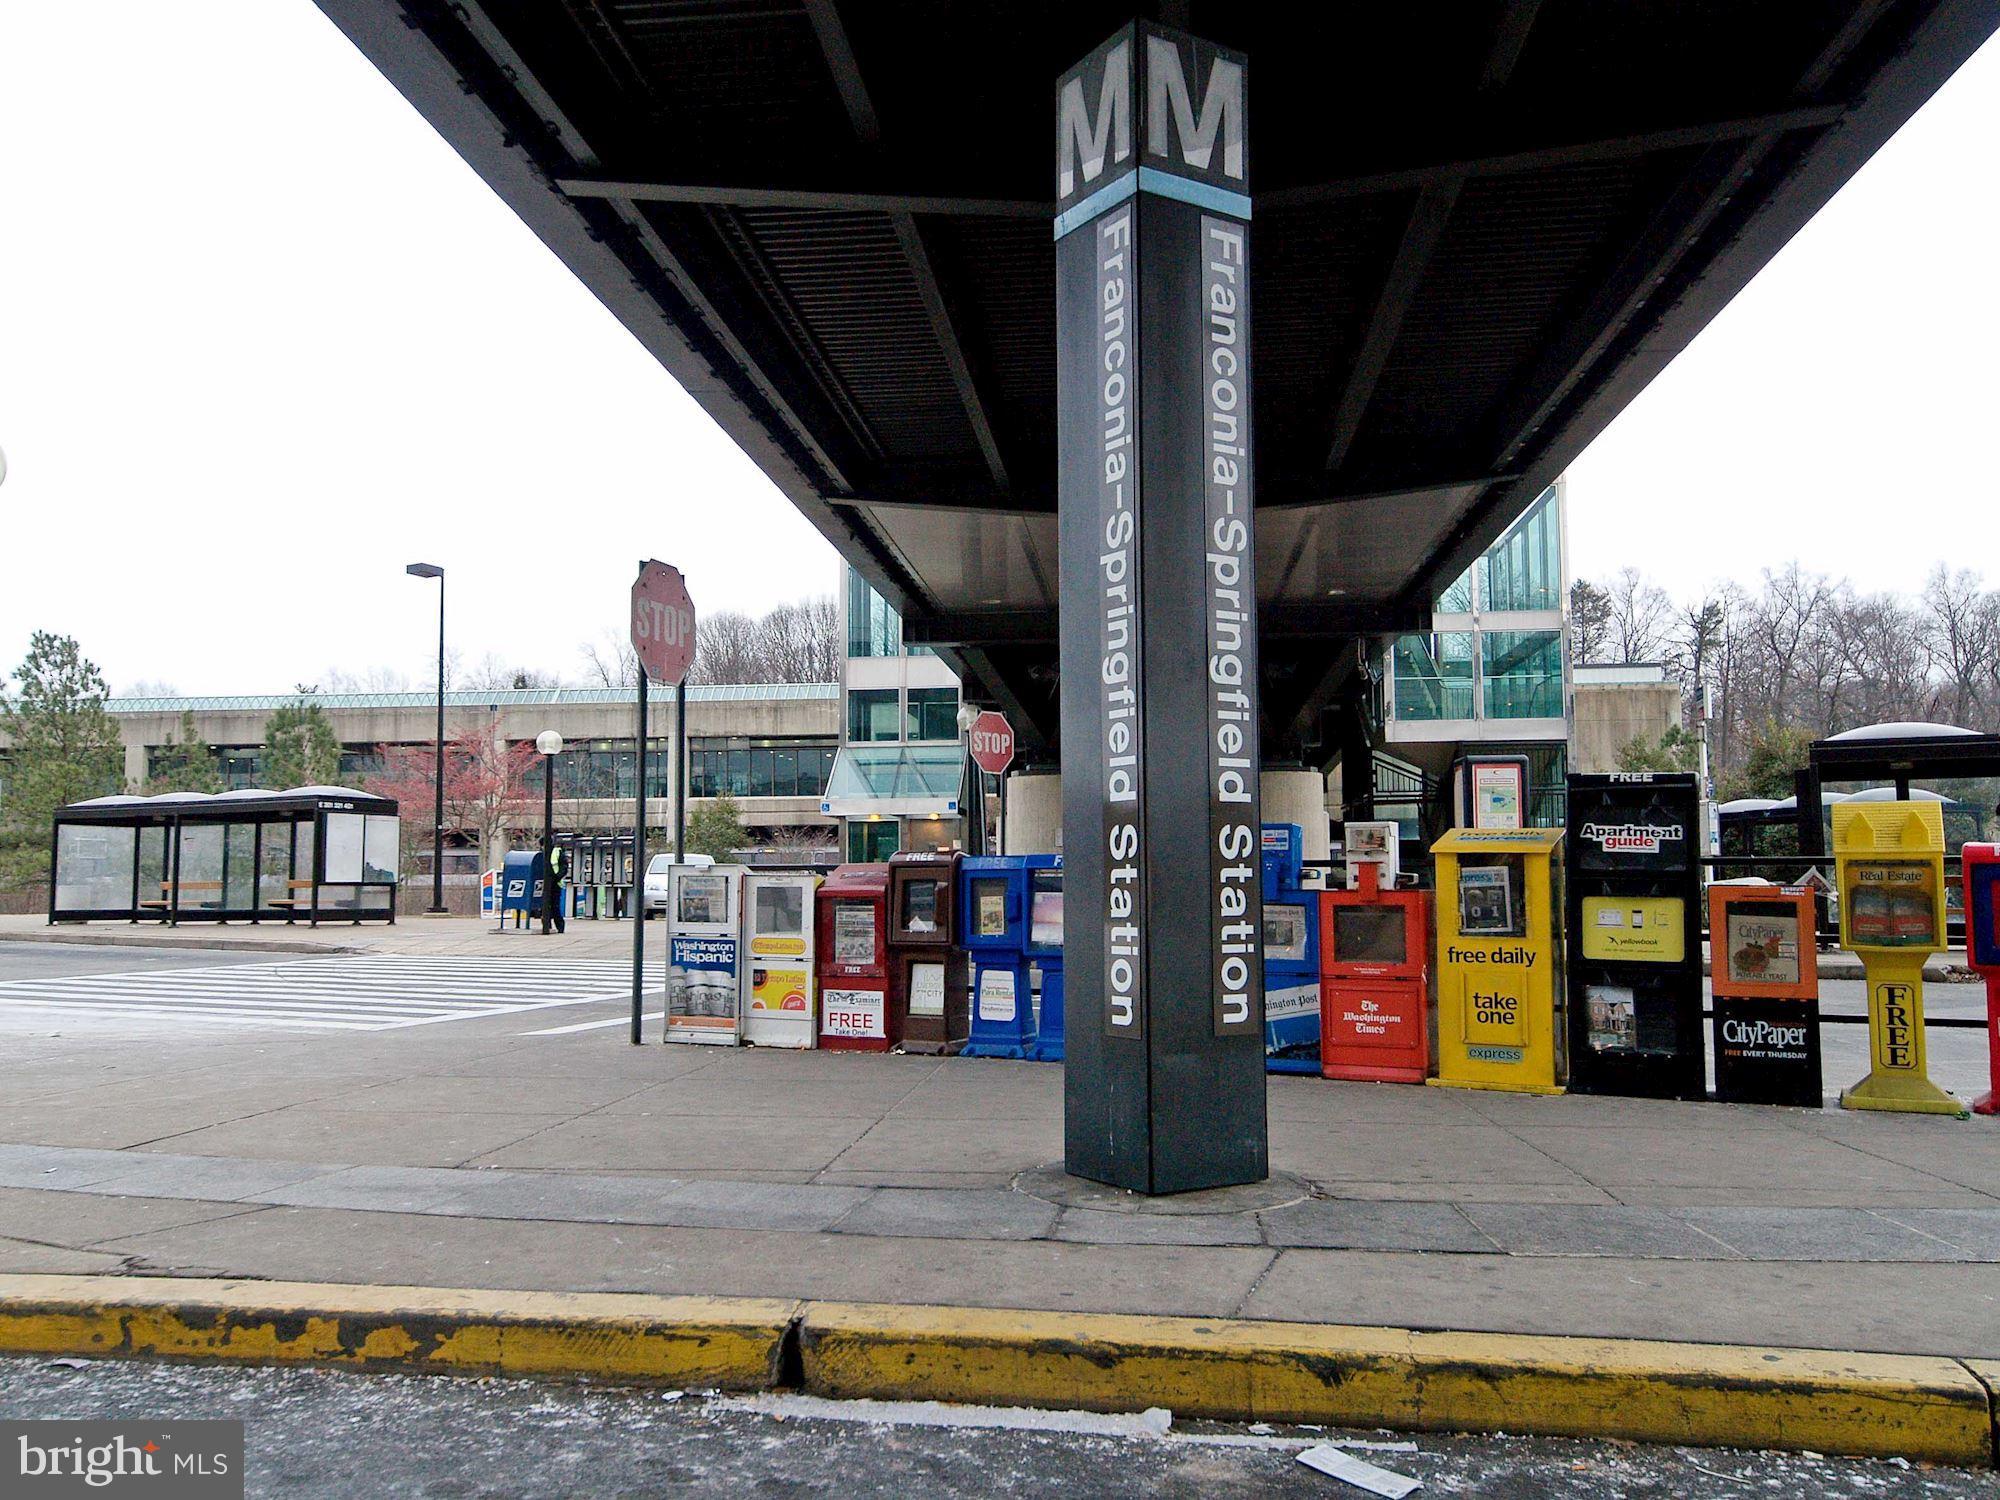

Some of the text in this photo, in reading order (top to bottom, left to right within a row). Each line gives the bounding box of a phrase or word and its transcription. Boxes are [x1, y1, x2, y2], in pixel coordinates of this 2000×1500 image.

[1147, 33, 1243, 181] M
[1060, 38, 1130, 200] M
[636, 597, 691, 648] STOP
[973, 731, 1010, 755] STOP
[1609, 773, 1654, 782] FREE
[1581, 824, 1682, 839] Apartment
[1604, 835, 1655, 849] guide
[905, 852, 936, 861] FREE
[1860, 871, 1922, 881] Real Estate
[1109, 823, 1139, 1026] Station
[1218, 823, 1255, 1024] Station
[674, 940, 734, 952] Washington
[1620, 938, 1658, 946] yellowbook
[675, 949, 734, 964] Hispanic
[1447, 947, 1536, 968] free daily
[844, 966, 861, 974] FREE
[827, 992, 881, 1005] The Examiner
[1264, 993, 1318, 1011] hington Post
[1360, 1000, 1380, 1012] The
[1472, 992, 1518, 1010] take
[829, 1012, 873, 1029] FREE
[1343, 1012, 1401, 1024] Washington
[1476, 1010, 1515, 1025] one
[835, 1028, 868, 1036] Take One!
[1355, 1023, 1385, 1034] Times
[1722, 1020, 1807, 1048] CityPaper
[1884, 986, 1911, 1067] FREE
[1469, 1048, 1521, 1060] express
[1724, 1049, 1808, 1059] FREE EVERY THURSDAY
